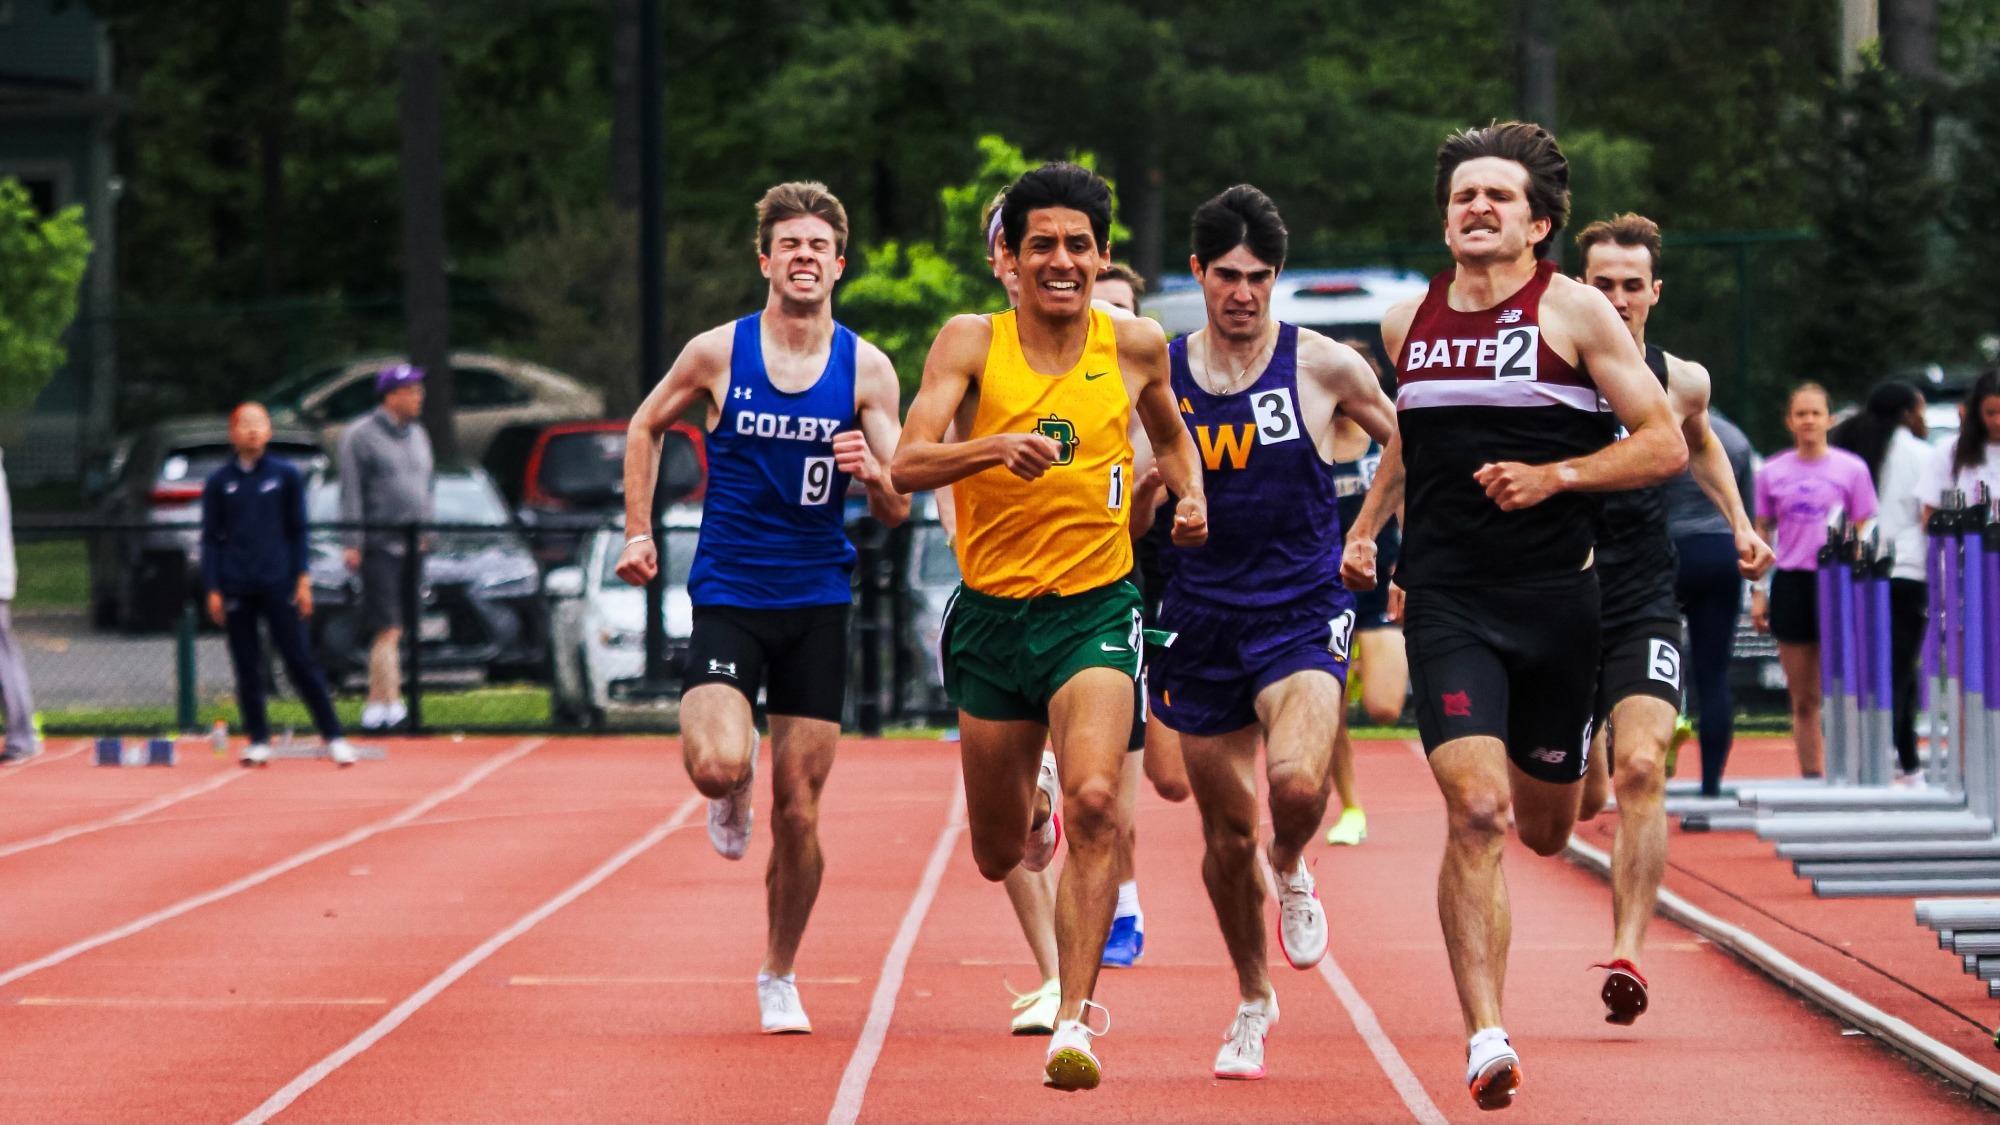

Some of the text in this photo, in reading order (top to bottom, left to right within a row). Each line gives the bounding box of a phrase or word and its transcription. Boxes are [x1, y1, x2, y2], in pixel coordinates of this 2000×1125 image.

[1499, 329, 1532, 377] 2
[736, 410, 841, 443] COLBY
[1257, 393, 1292, 438] 3
[1195, 423, 1257, 470] W
[806, 460, 829, 503] 9
[1655, 643, 1677, 680] 5
